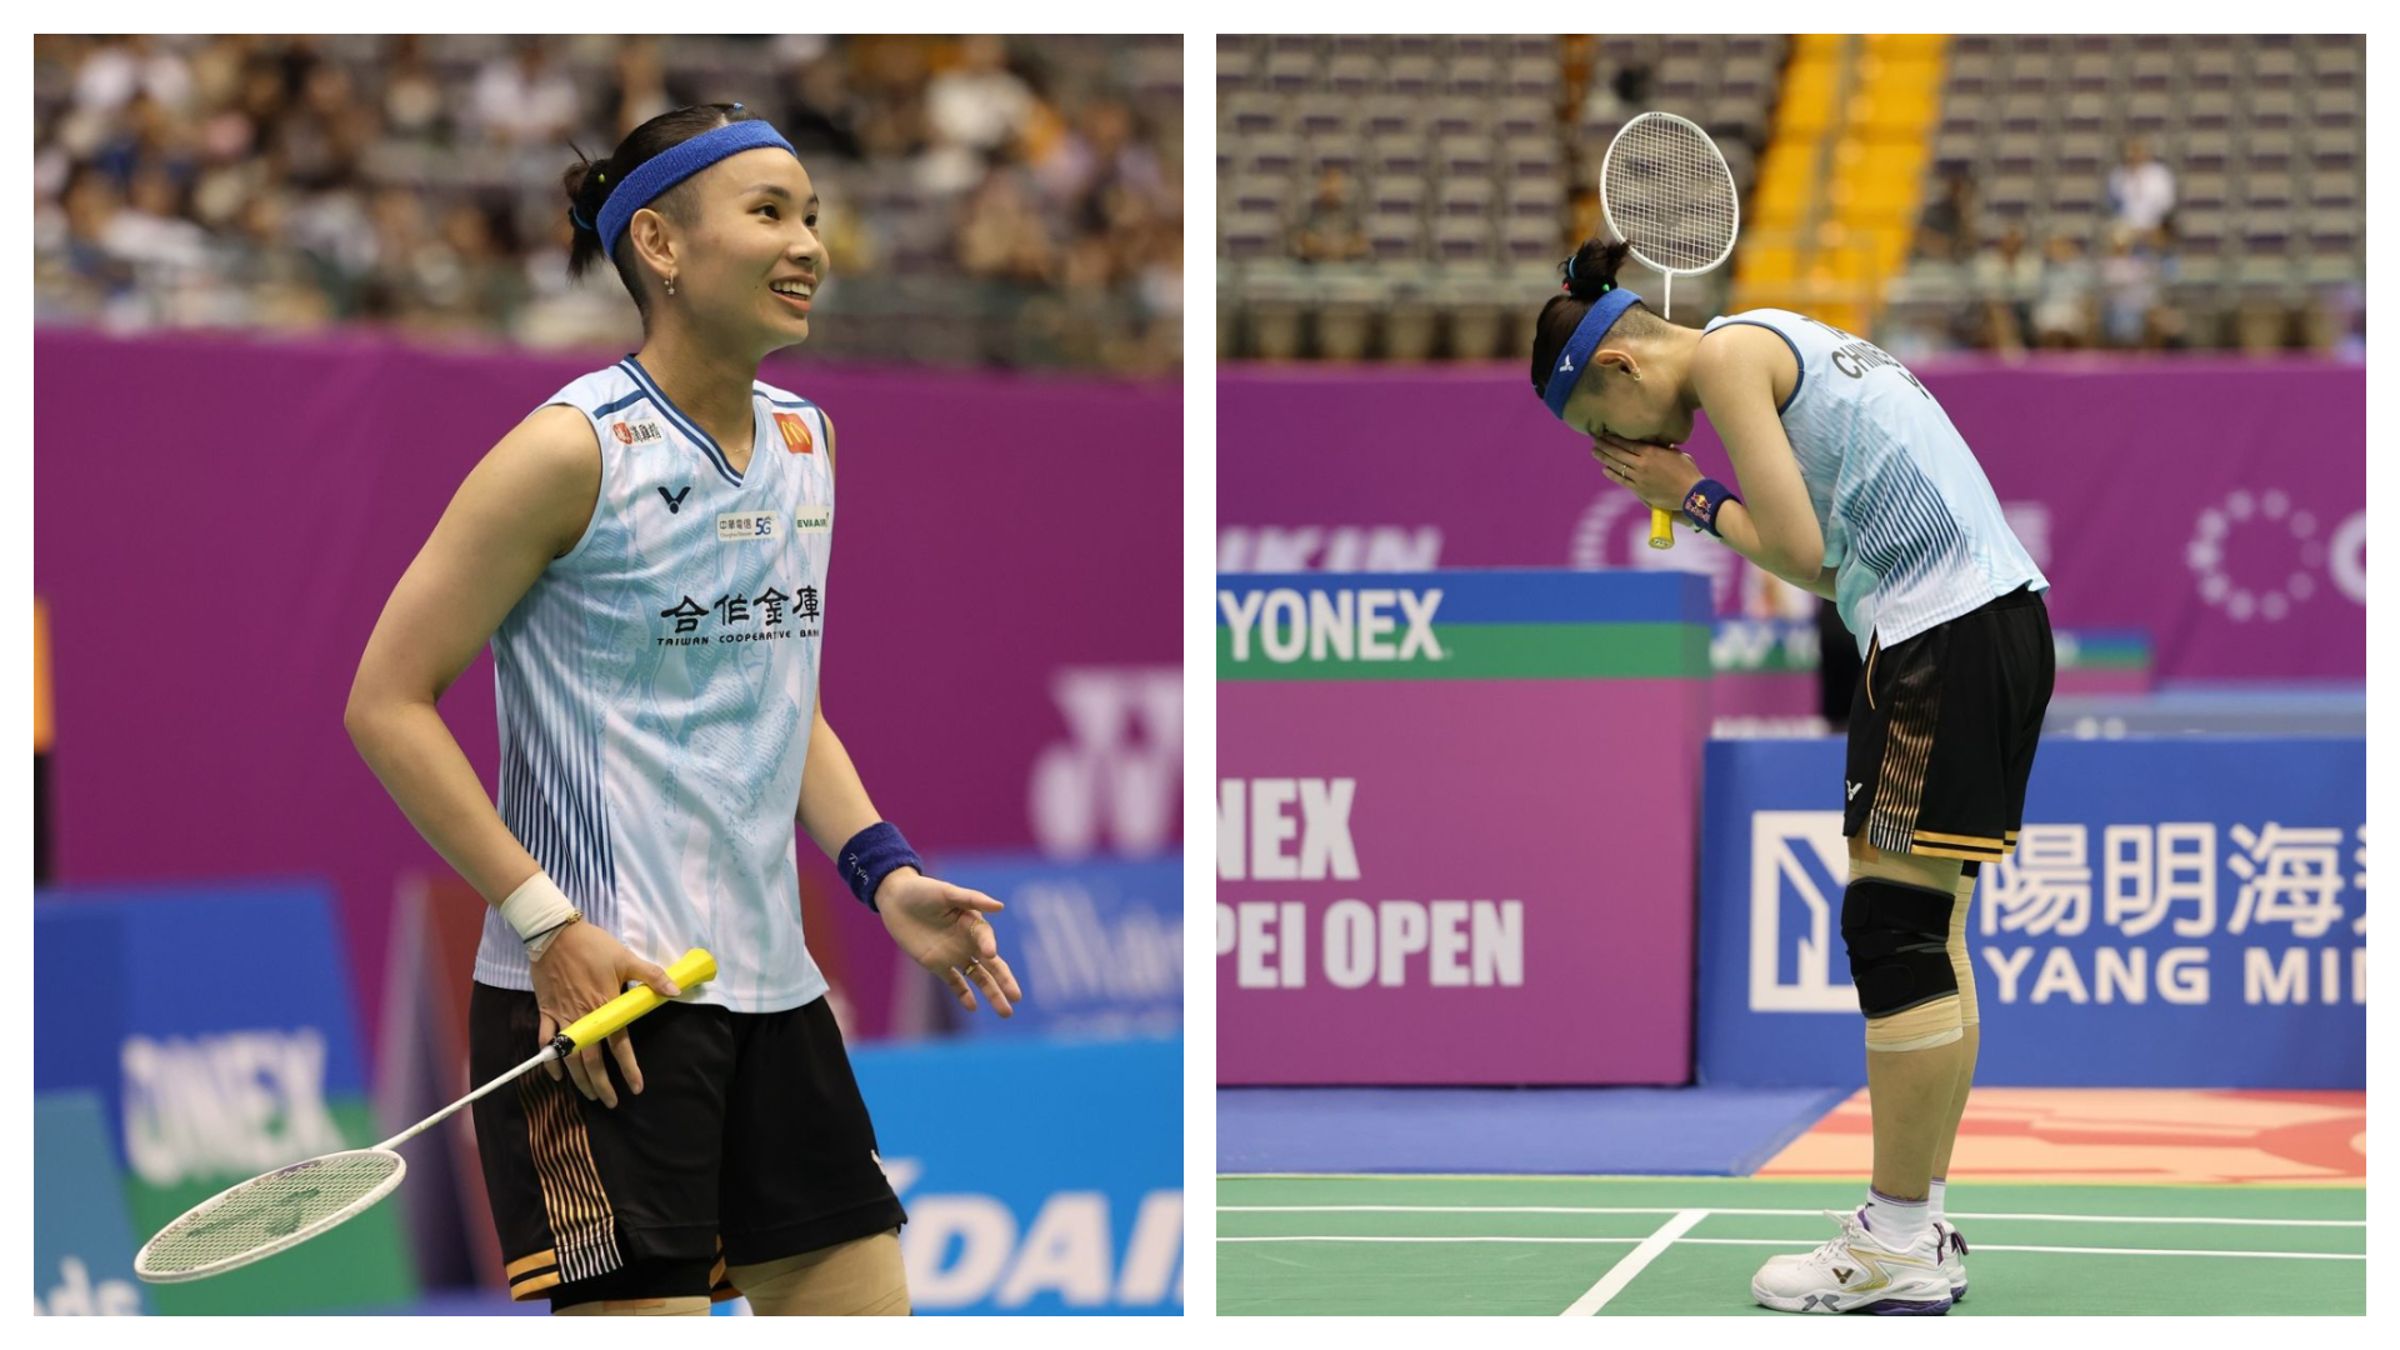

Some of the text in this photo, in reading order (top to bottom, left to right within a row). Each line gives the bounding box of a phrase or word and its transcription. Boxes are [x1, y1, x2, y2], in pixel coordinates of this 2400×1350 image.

[656, 636, 709, 647] TAIWAN
[660, 585, 820, 634] 合作金庫
[1217, 588, 1444, 663] YONEX
[1980, 821, 2366, 937] 陽明海
[1322, 898, 1524, 990] OPEN
[1981, 946, 2211, 1005] YANG
[902, 1190, 1184, 1309] DAI
